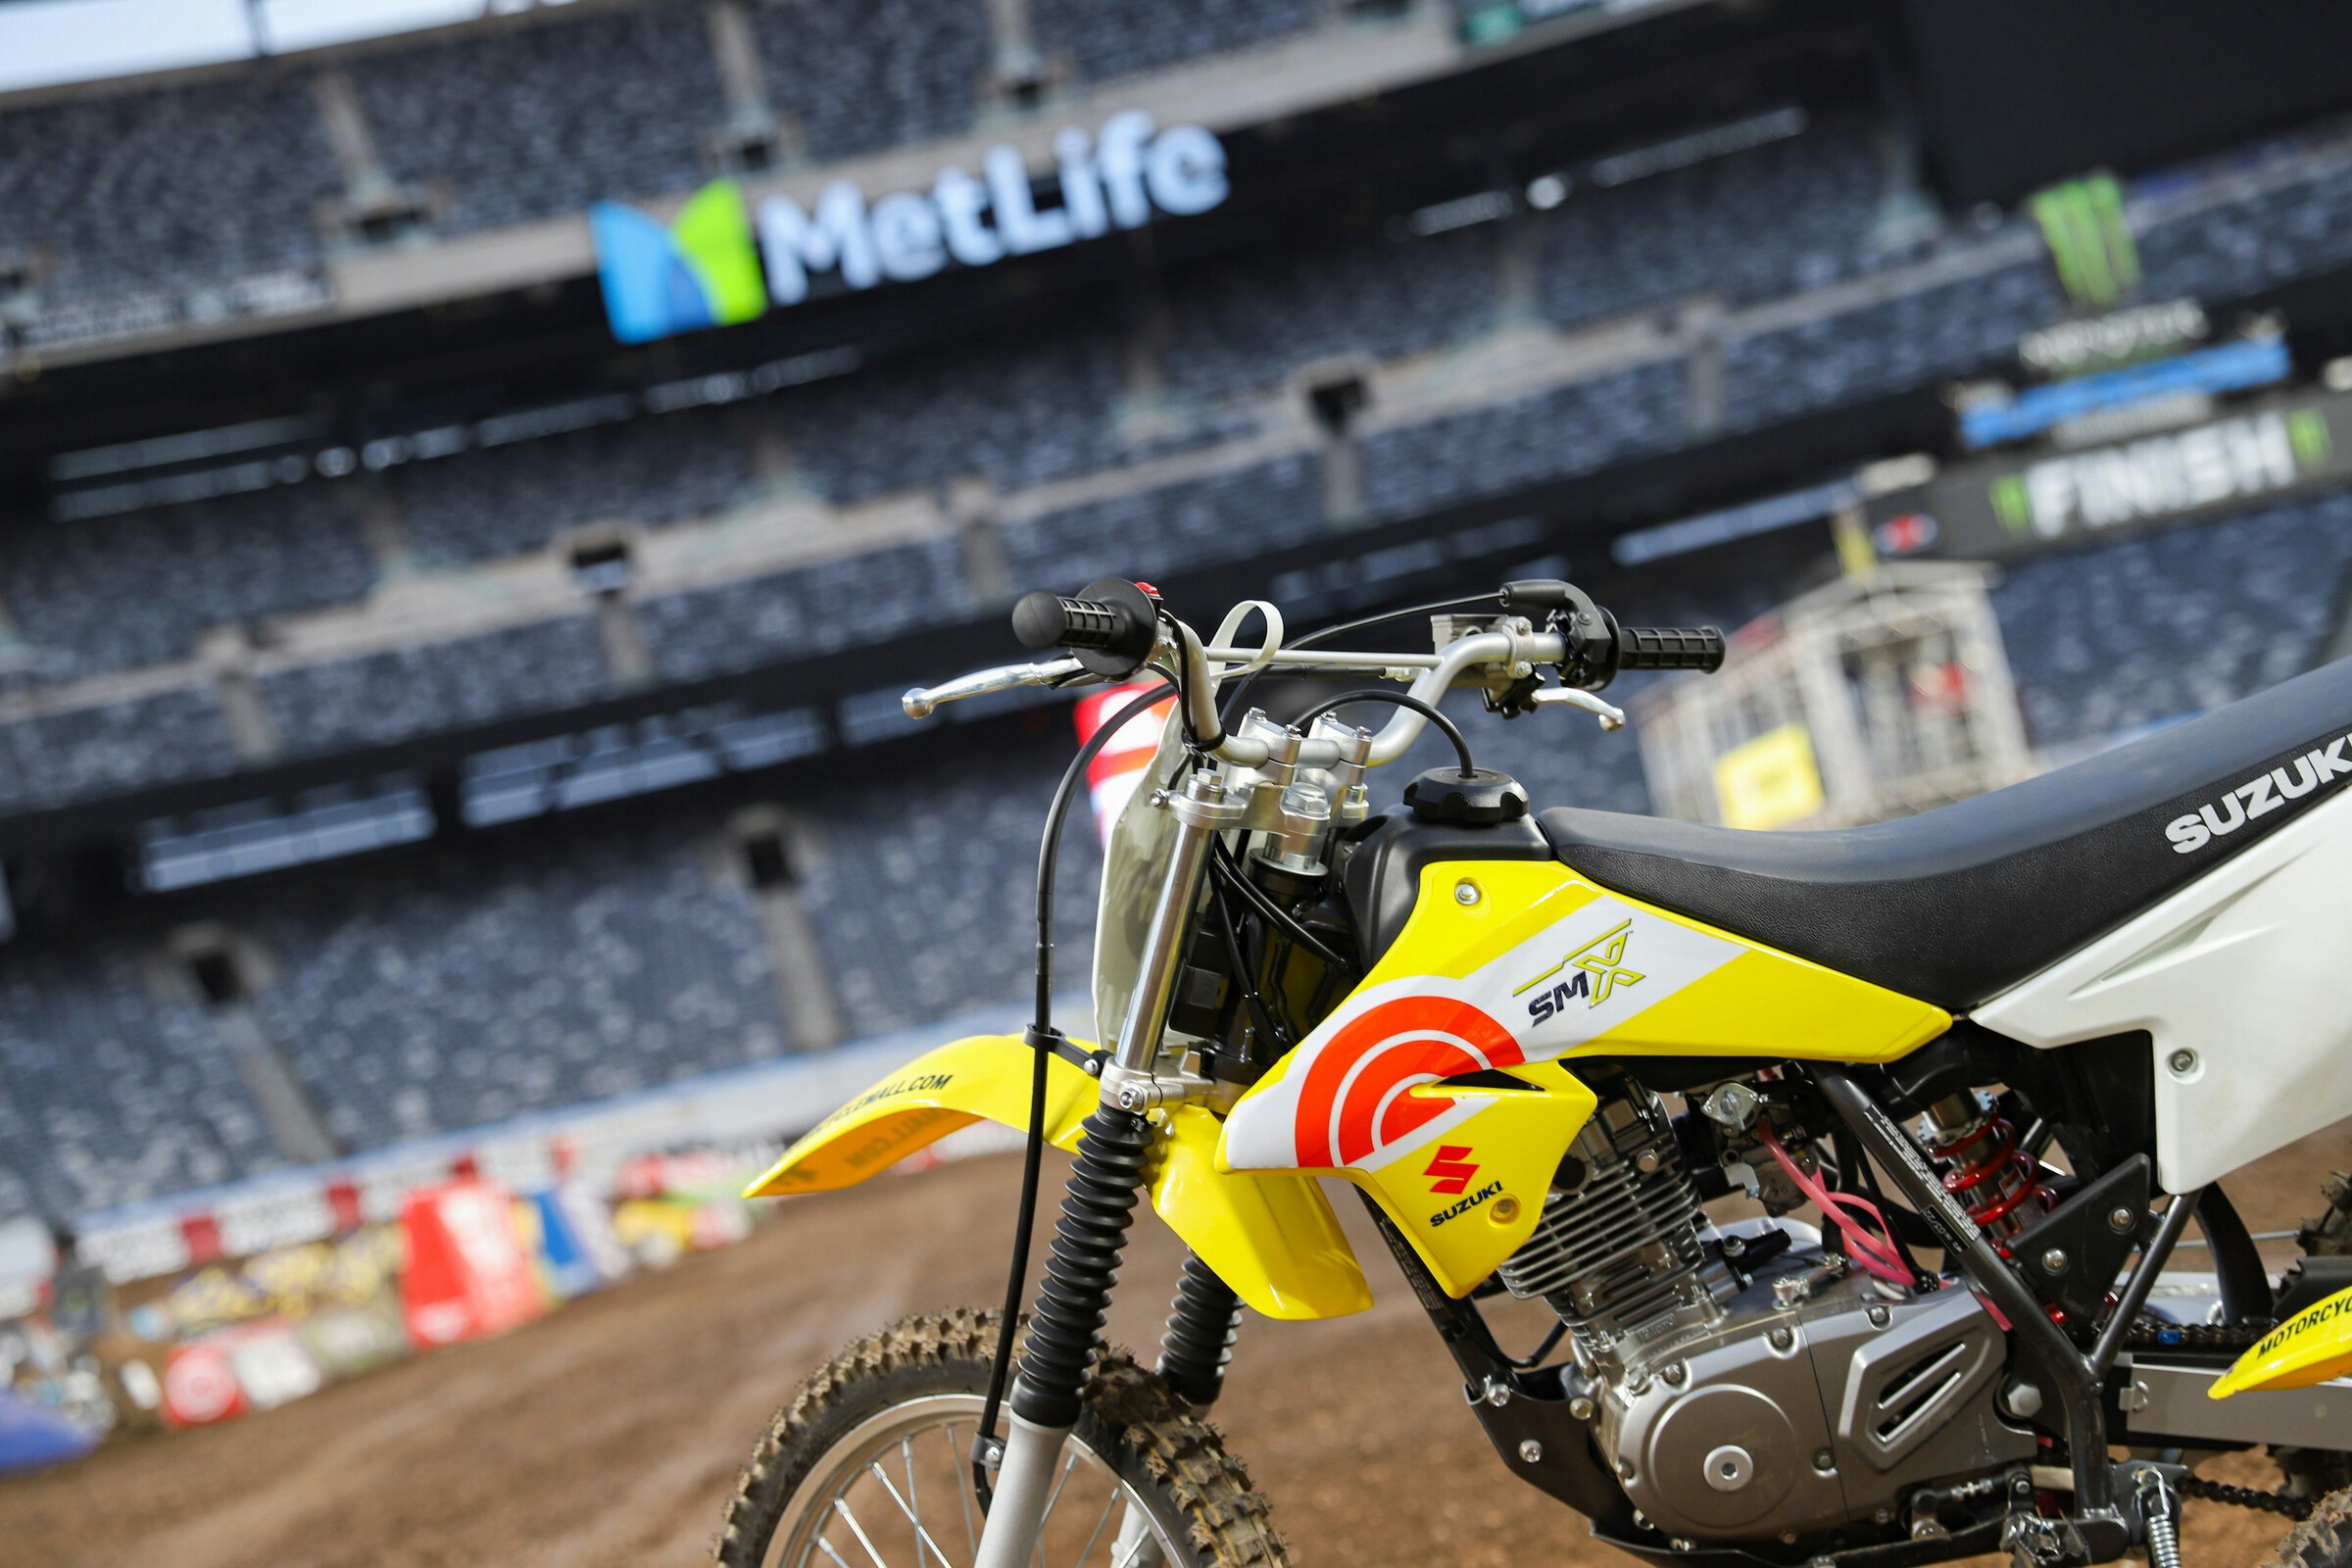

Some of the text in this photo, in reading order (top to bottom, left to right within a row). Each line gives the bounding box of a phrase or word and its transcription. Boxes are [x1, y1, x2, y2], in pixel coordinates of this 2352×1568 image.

[759, 109, 1230, 306] MetLife
[2027, 411, 2296, 539] FINISH
[2165, 733, 2352, 854] SUZUK
[1528, 933, 1645, 1027] SMX
[1430, 1181, 1502, 1227] SUZUKI
